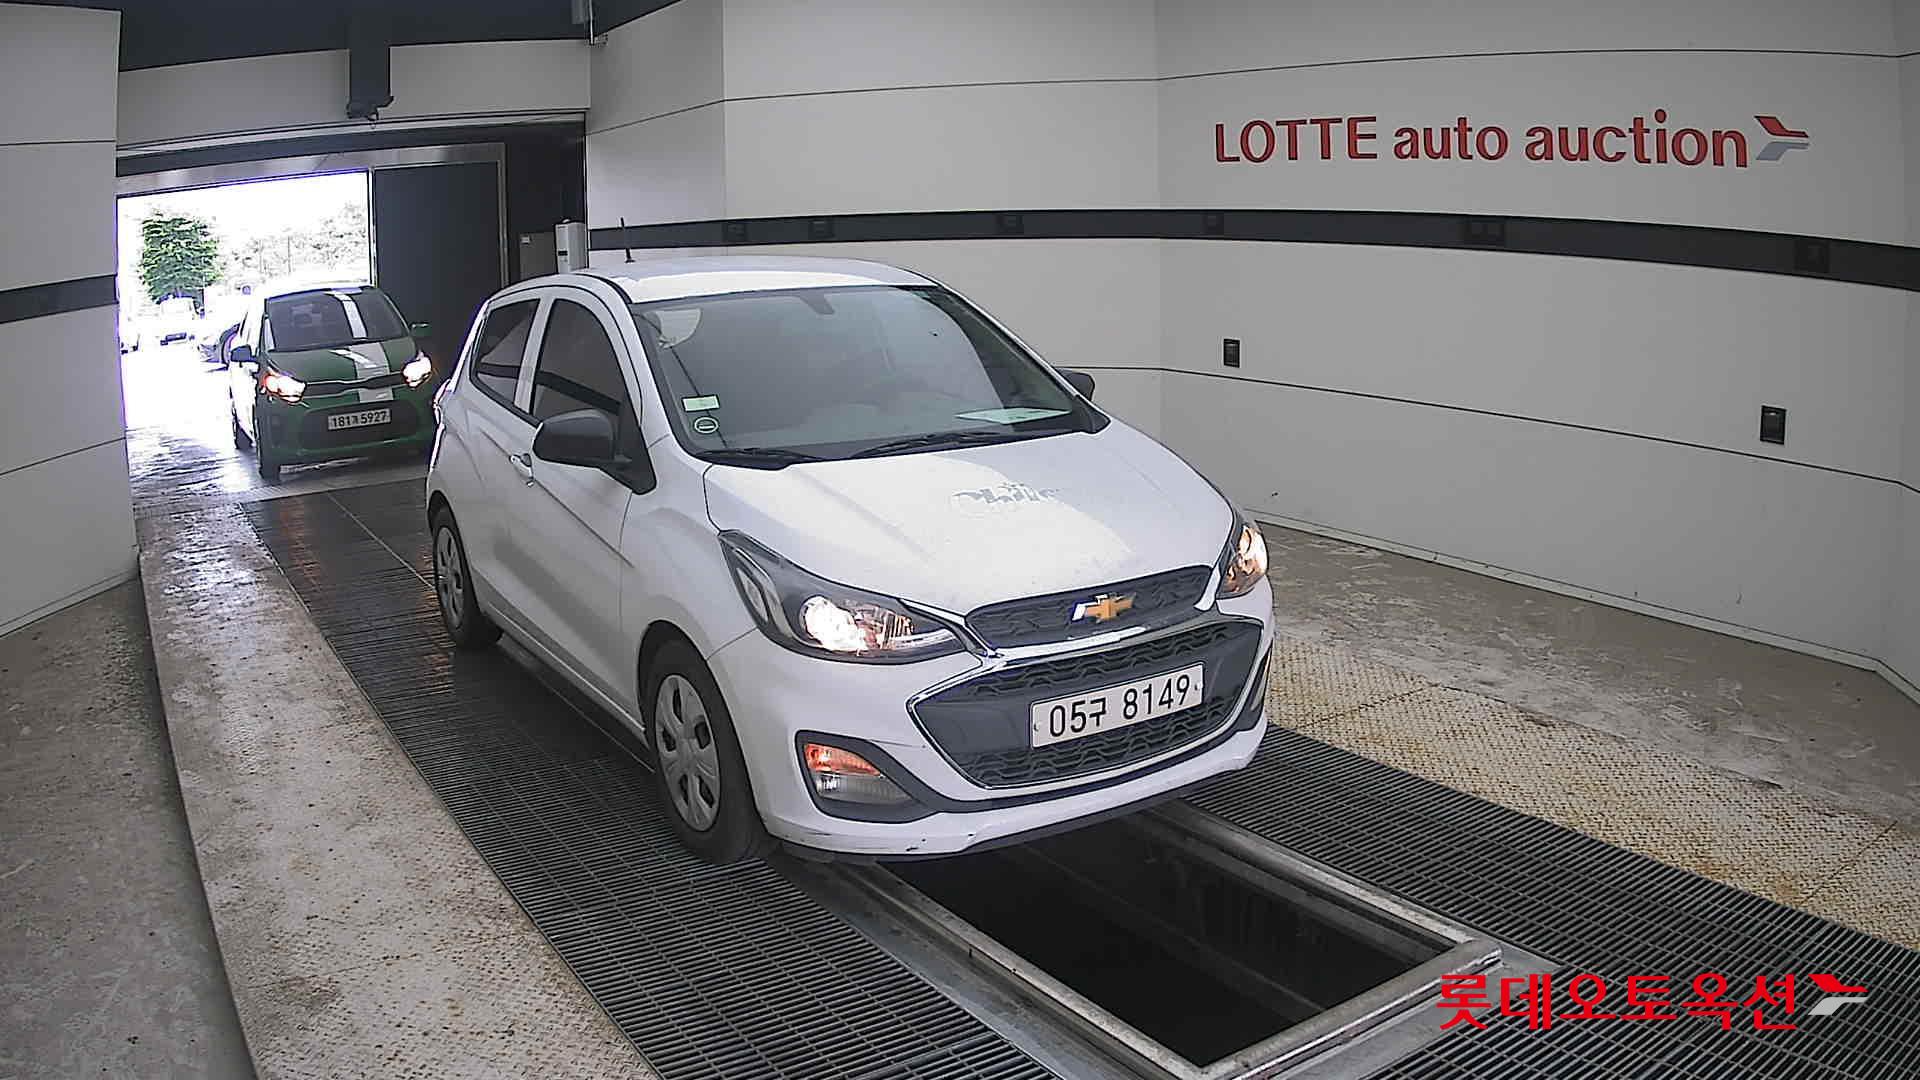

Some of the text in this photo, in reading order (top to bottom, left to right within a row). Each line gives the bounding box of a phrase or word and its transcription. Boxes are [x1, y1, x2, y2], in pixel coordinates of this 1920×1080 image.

[1215, 109, 1748, 168] LOTTE auto auction
[1050, 675, 1190, 737] 05구 8149
